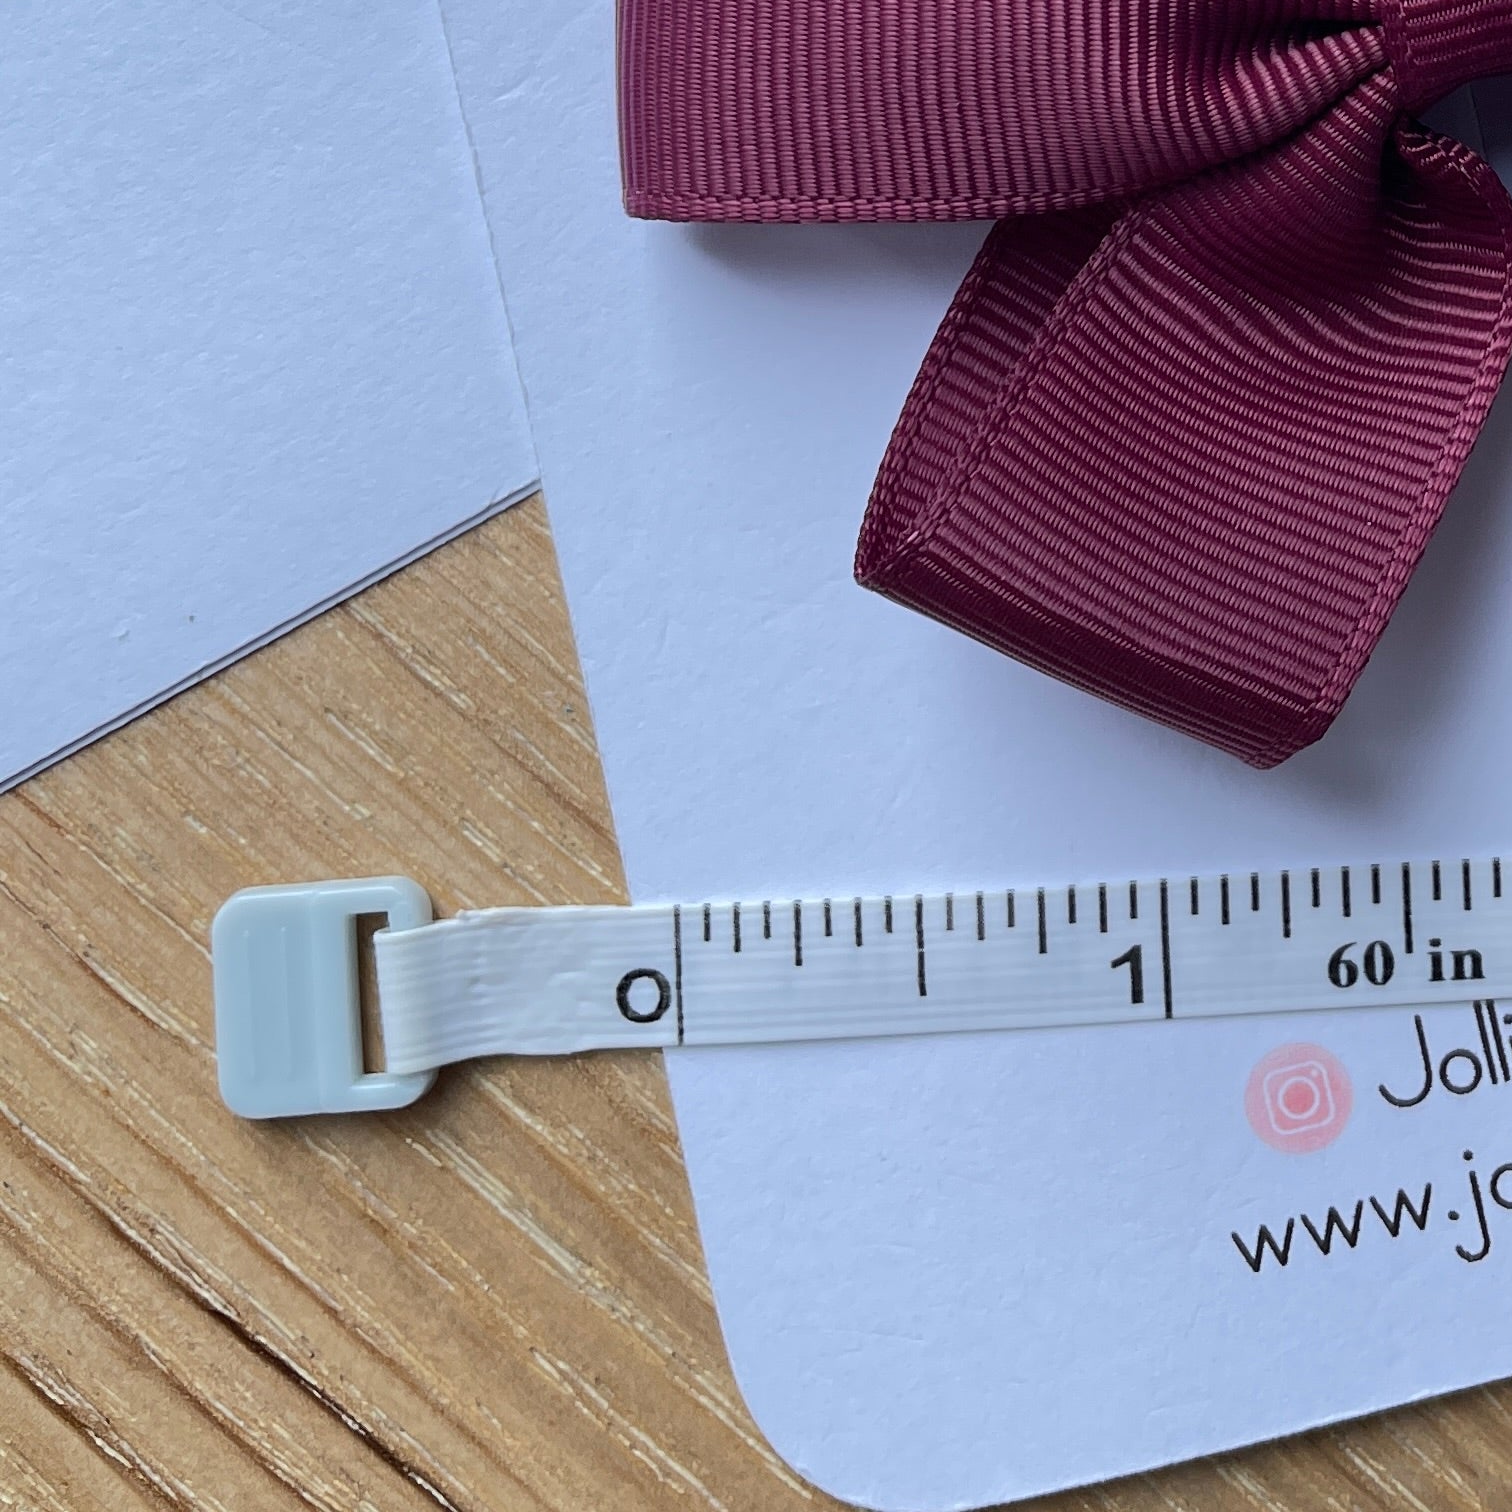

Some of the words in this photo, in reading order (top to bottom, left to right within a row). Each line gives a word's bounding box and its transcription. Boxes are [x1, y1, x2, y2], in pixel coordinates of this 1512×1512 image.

[1109, 944, 1145, 1005] 1
[1327, 939, 1396, 989] 60
[1426, 937, 1487, 983] in
